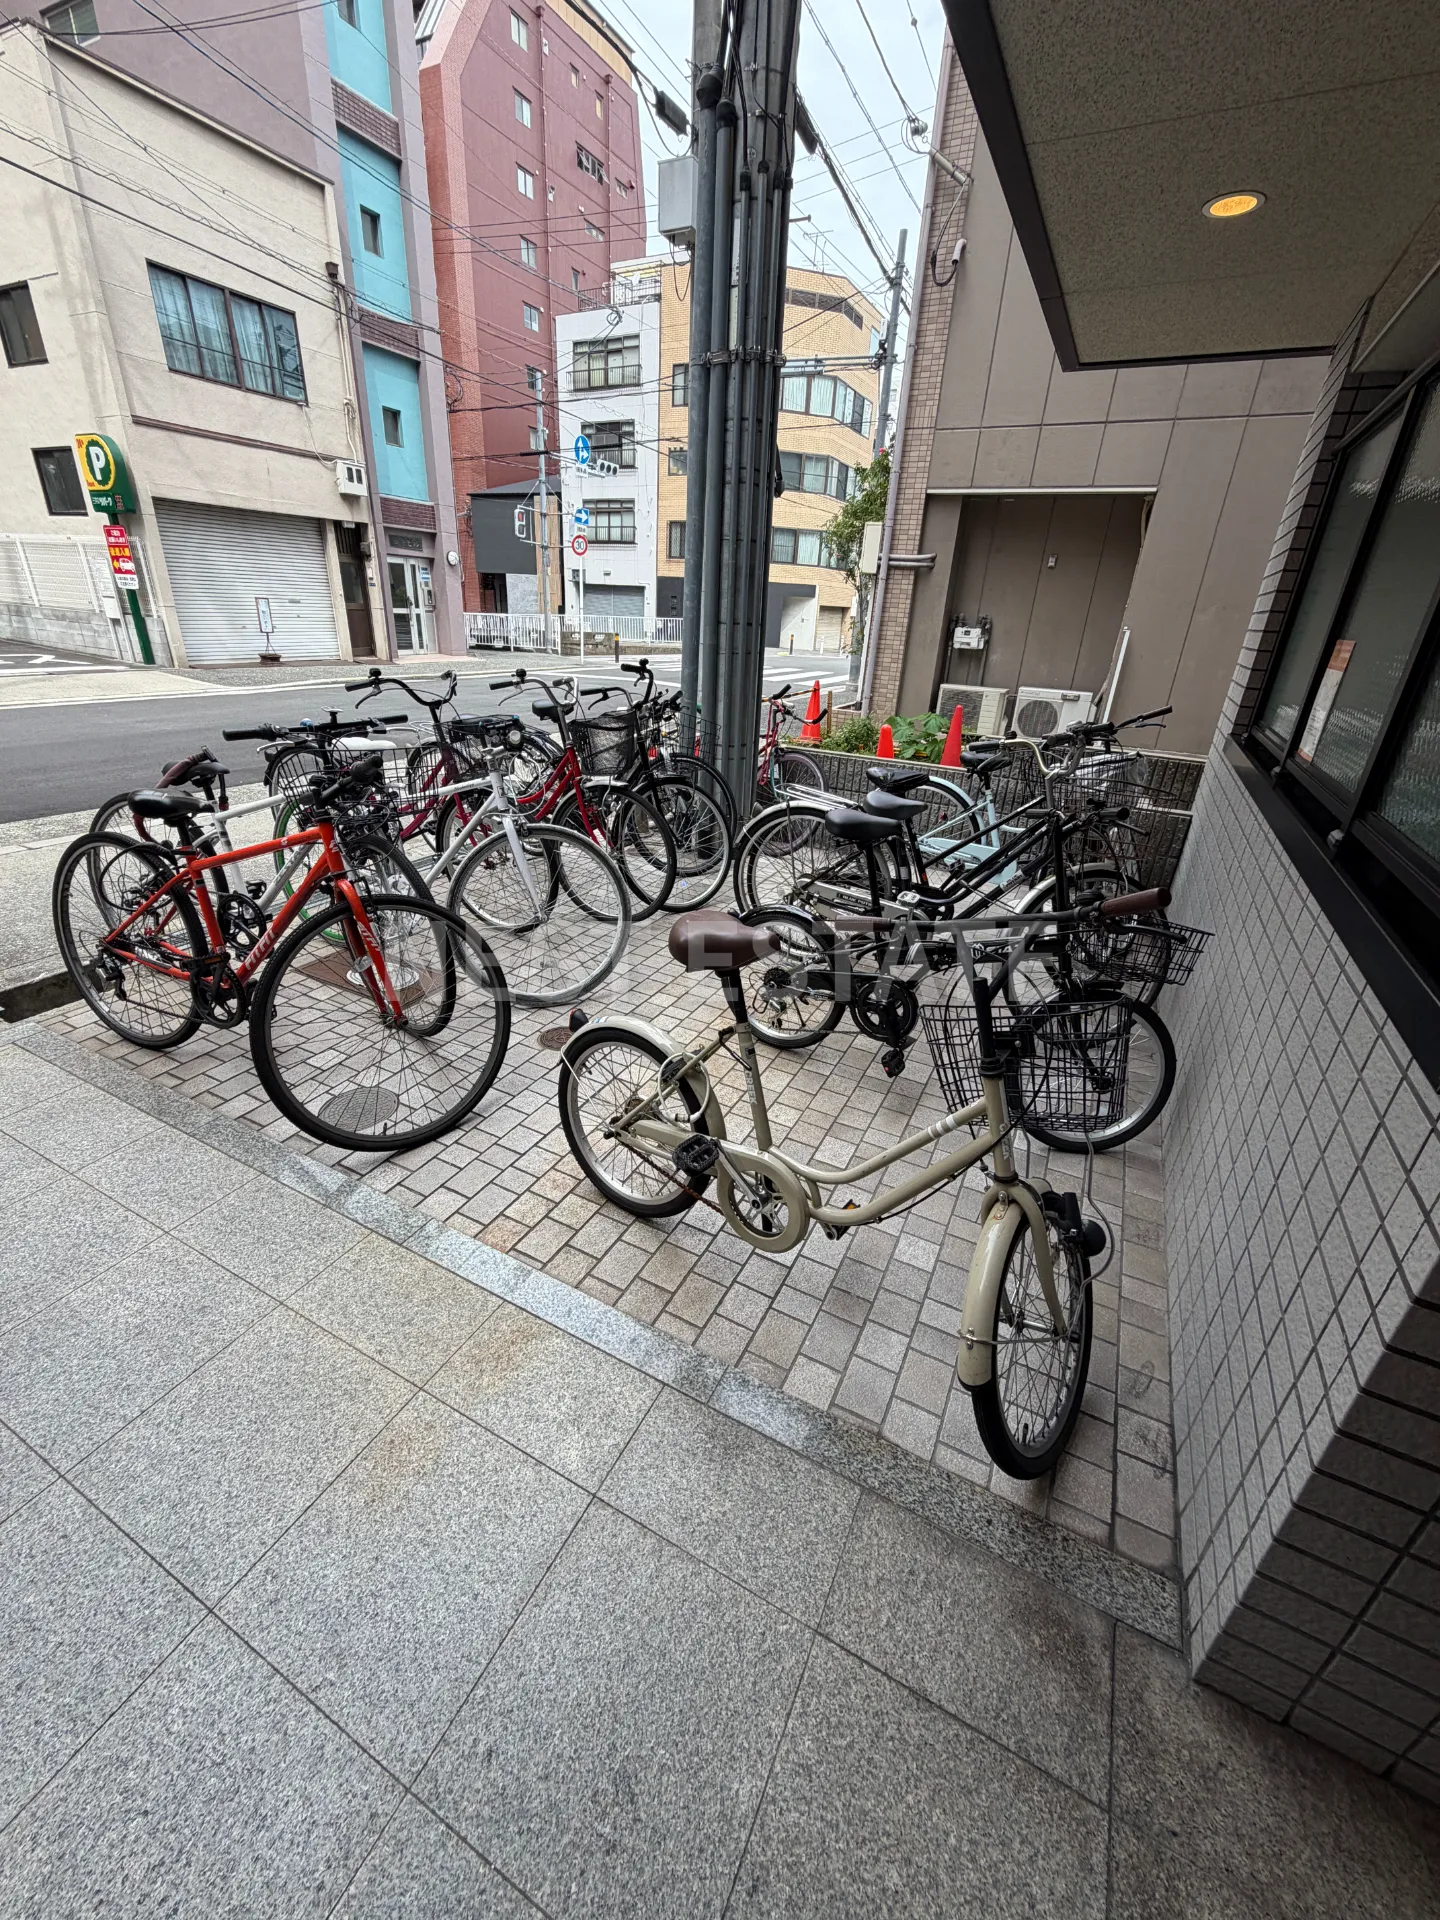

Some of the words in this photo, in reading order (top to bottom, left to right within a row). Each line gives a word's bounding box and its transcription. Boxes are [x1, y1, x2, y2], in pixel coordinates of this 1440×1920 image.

[88, 446, 106, 481] P
[575, 540, 585, 551] 30
[744, 1070, 758, 1106] CREEK
[998, 1122, 1013, 1161] CEEK
